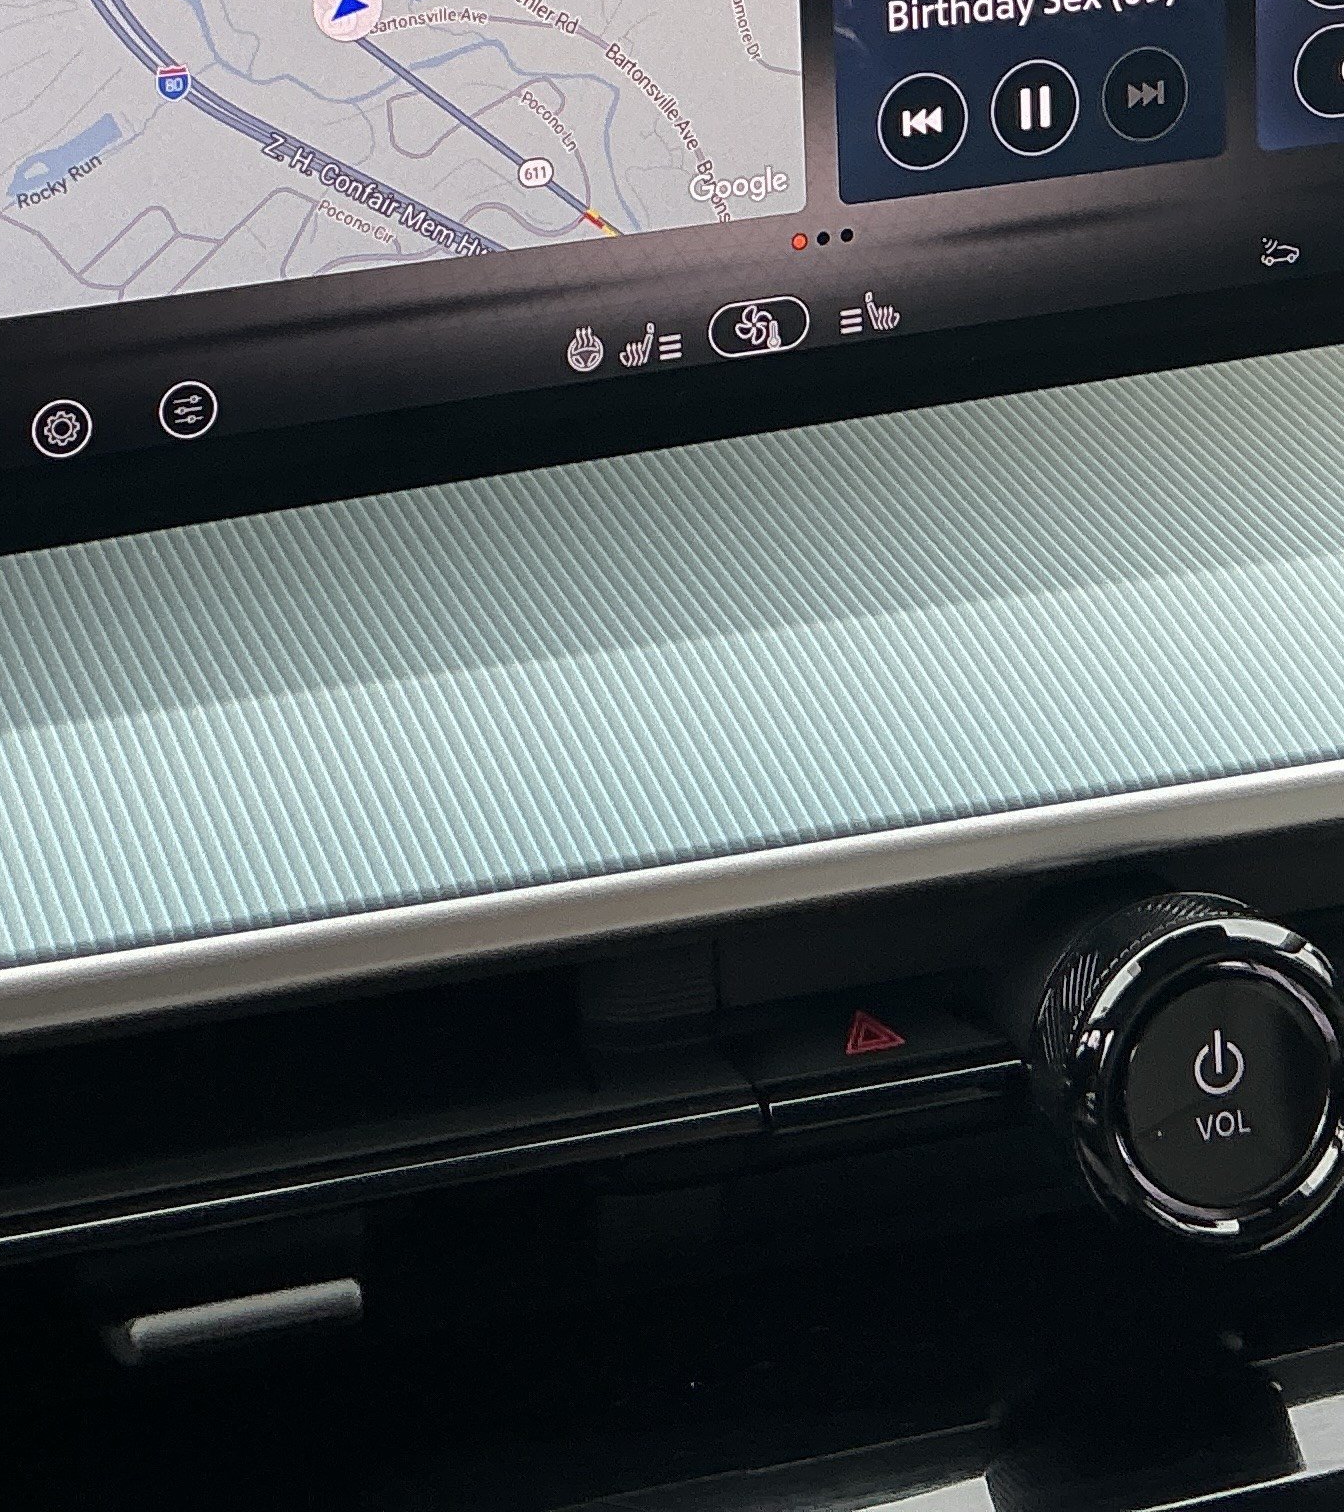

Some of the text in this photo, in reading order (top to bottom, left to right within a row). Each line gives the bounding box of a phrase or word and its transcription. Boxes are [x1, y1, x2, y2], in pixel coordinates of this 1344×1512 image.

[460, 7, 488, 25] Ave
[554, 11, 580, 35] Rd
[746, 42, 761, 60] Dr
[164, 78, 183, 93] 80
[605, 43, 699, 151] Bartonsville Ave
[522, 90, 577, 153] Pocono Ln
[16, 155, 103, 209] Rocky Run
[524, 165, 547, 180] 611
[689, 166, 788, 202] Google
[318, 199, 394, 244] Pocono Cir
[319, 162, 402, 218] Confair
[399, 200, 456, 248] Mem
[1196, 1110, 1252, 1142] VOL
